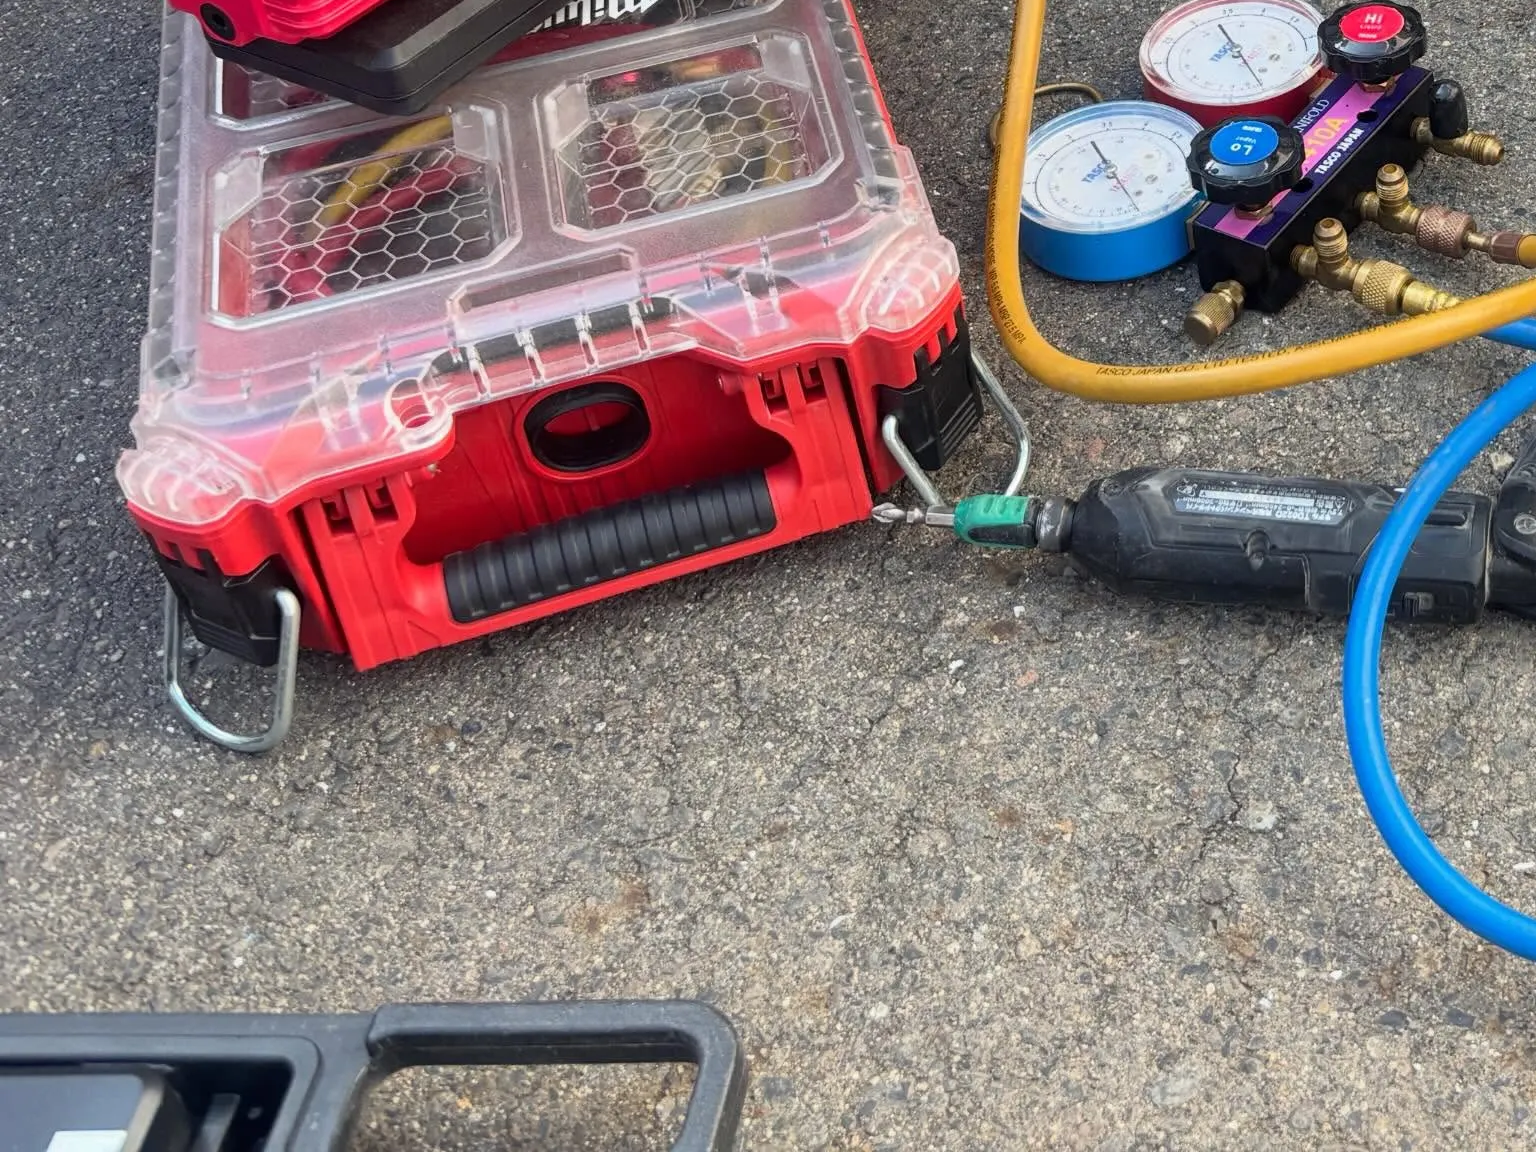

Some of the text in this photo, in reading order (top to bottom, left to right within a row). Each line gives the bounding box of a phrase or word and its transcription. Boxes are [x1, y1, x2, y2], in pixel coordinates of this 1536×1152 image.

[1364, 13, 1384, 24] Hi
[1292, 99, 1330, 133] NIFOLD
[1229, 144, 1253, 157] Lo
[1313, 127, 1366, 174] TASCO JAPAN
[1096, 367, 1132, 376] TASCO
[1132, 366, 1172, 376] JAPAN
